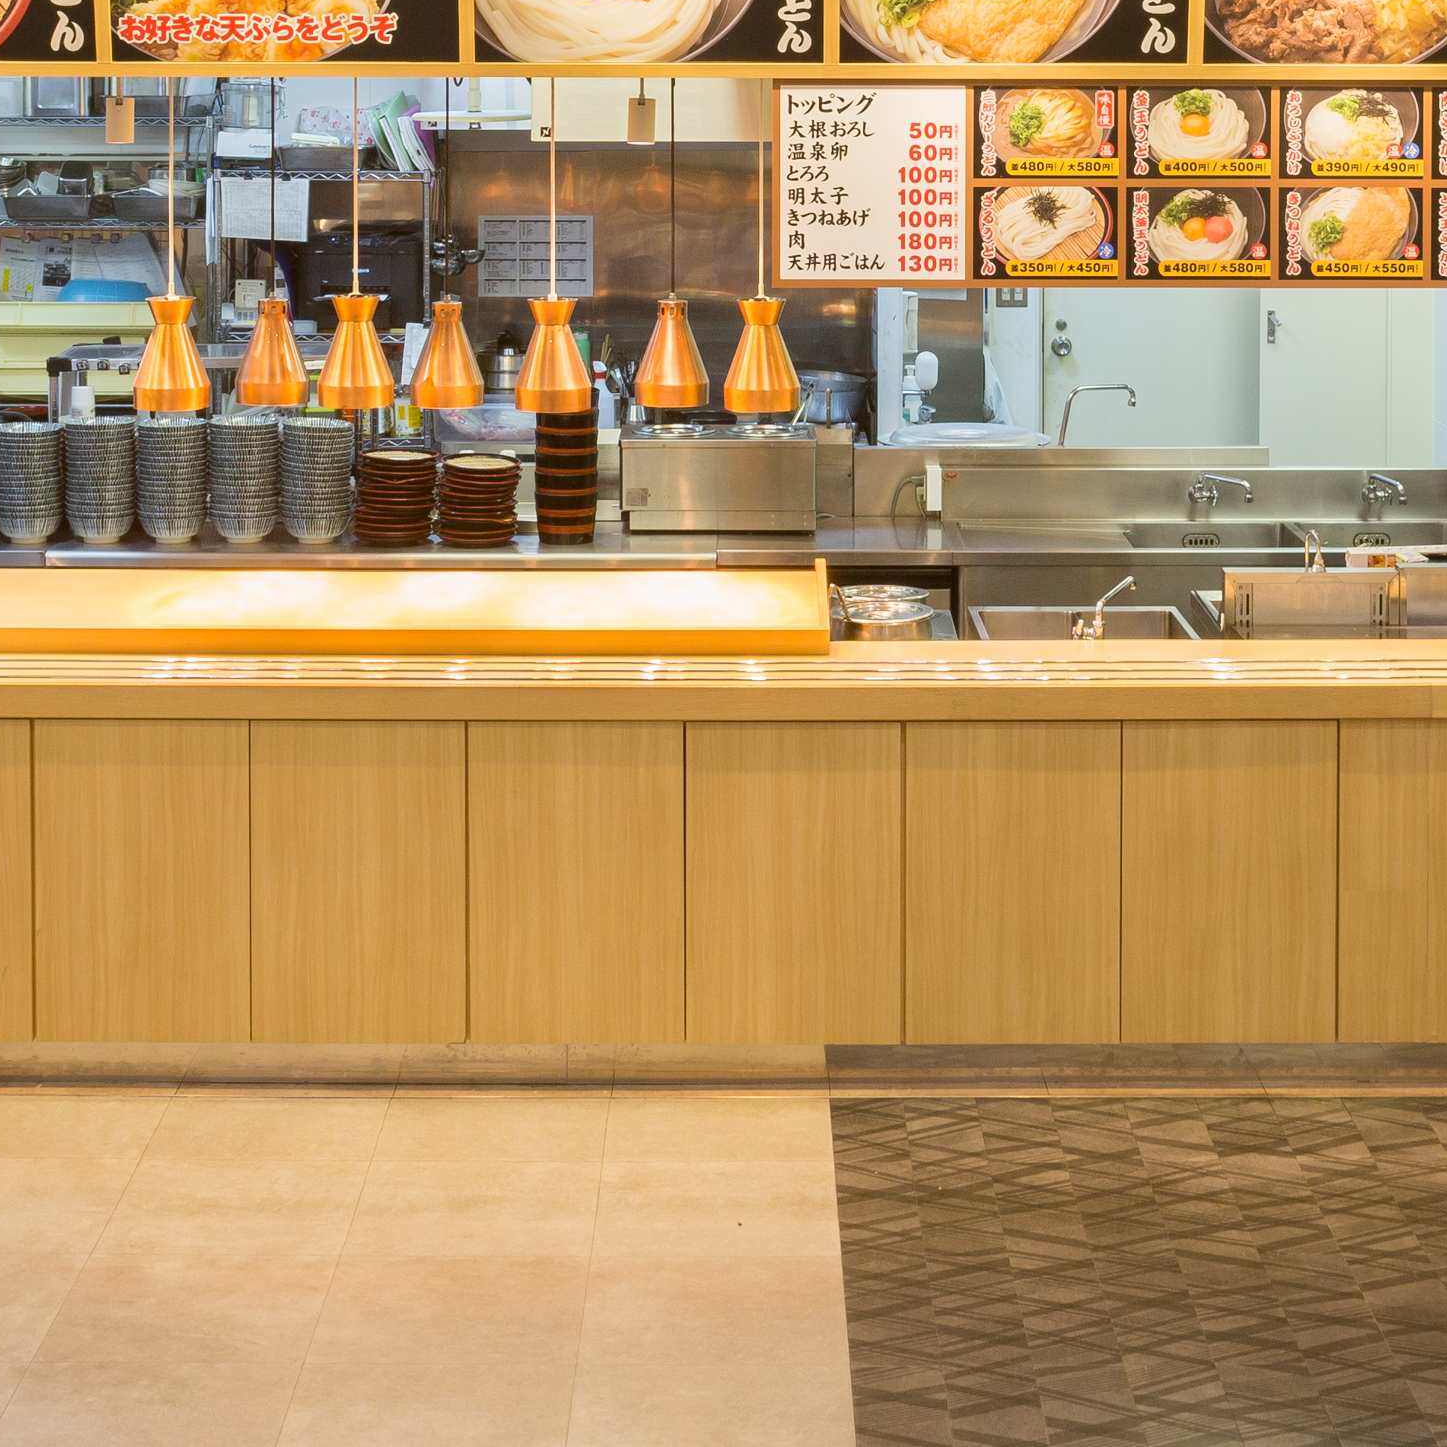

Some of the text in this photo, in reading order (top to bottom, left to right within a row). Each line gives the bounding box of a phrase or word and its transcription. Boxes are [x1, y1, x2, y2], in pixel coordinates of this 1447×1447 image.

[117, 11, 399, 44] お好きな天ぷらをどうぞ
[786, 92, 878, 116] トッピング
[788, 119, 953, 139] 大根おろし 50円
[788, 143, 953, 162] 温泉卵 60円
[786, 165, 953, 183] とろろ 100円
[788, 186, 953, 206] 明太子 100円
[786, 208, 953, 228] きつねあげ 100円
[788, 230, 953, 250] 肉 180円
[897, 255, 953, 272] 130円
